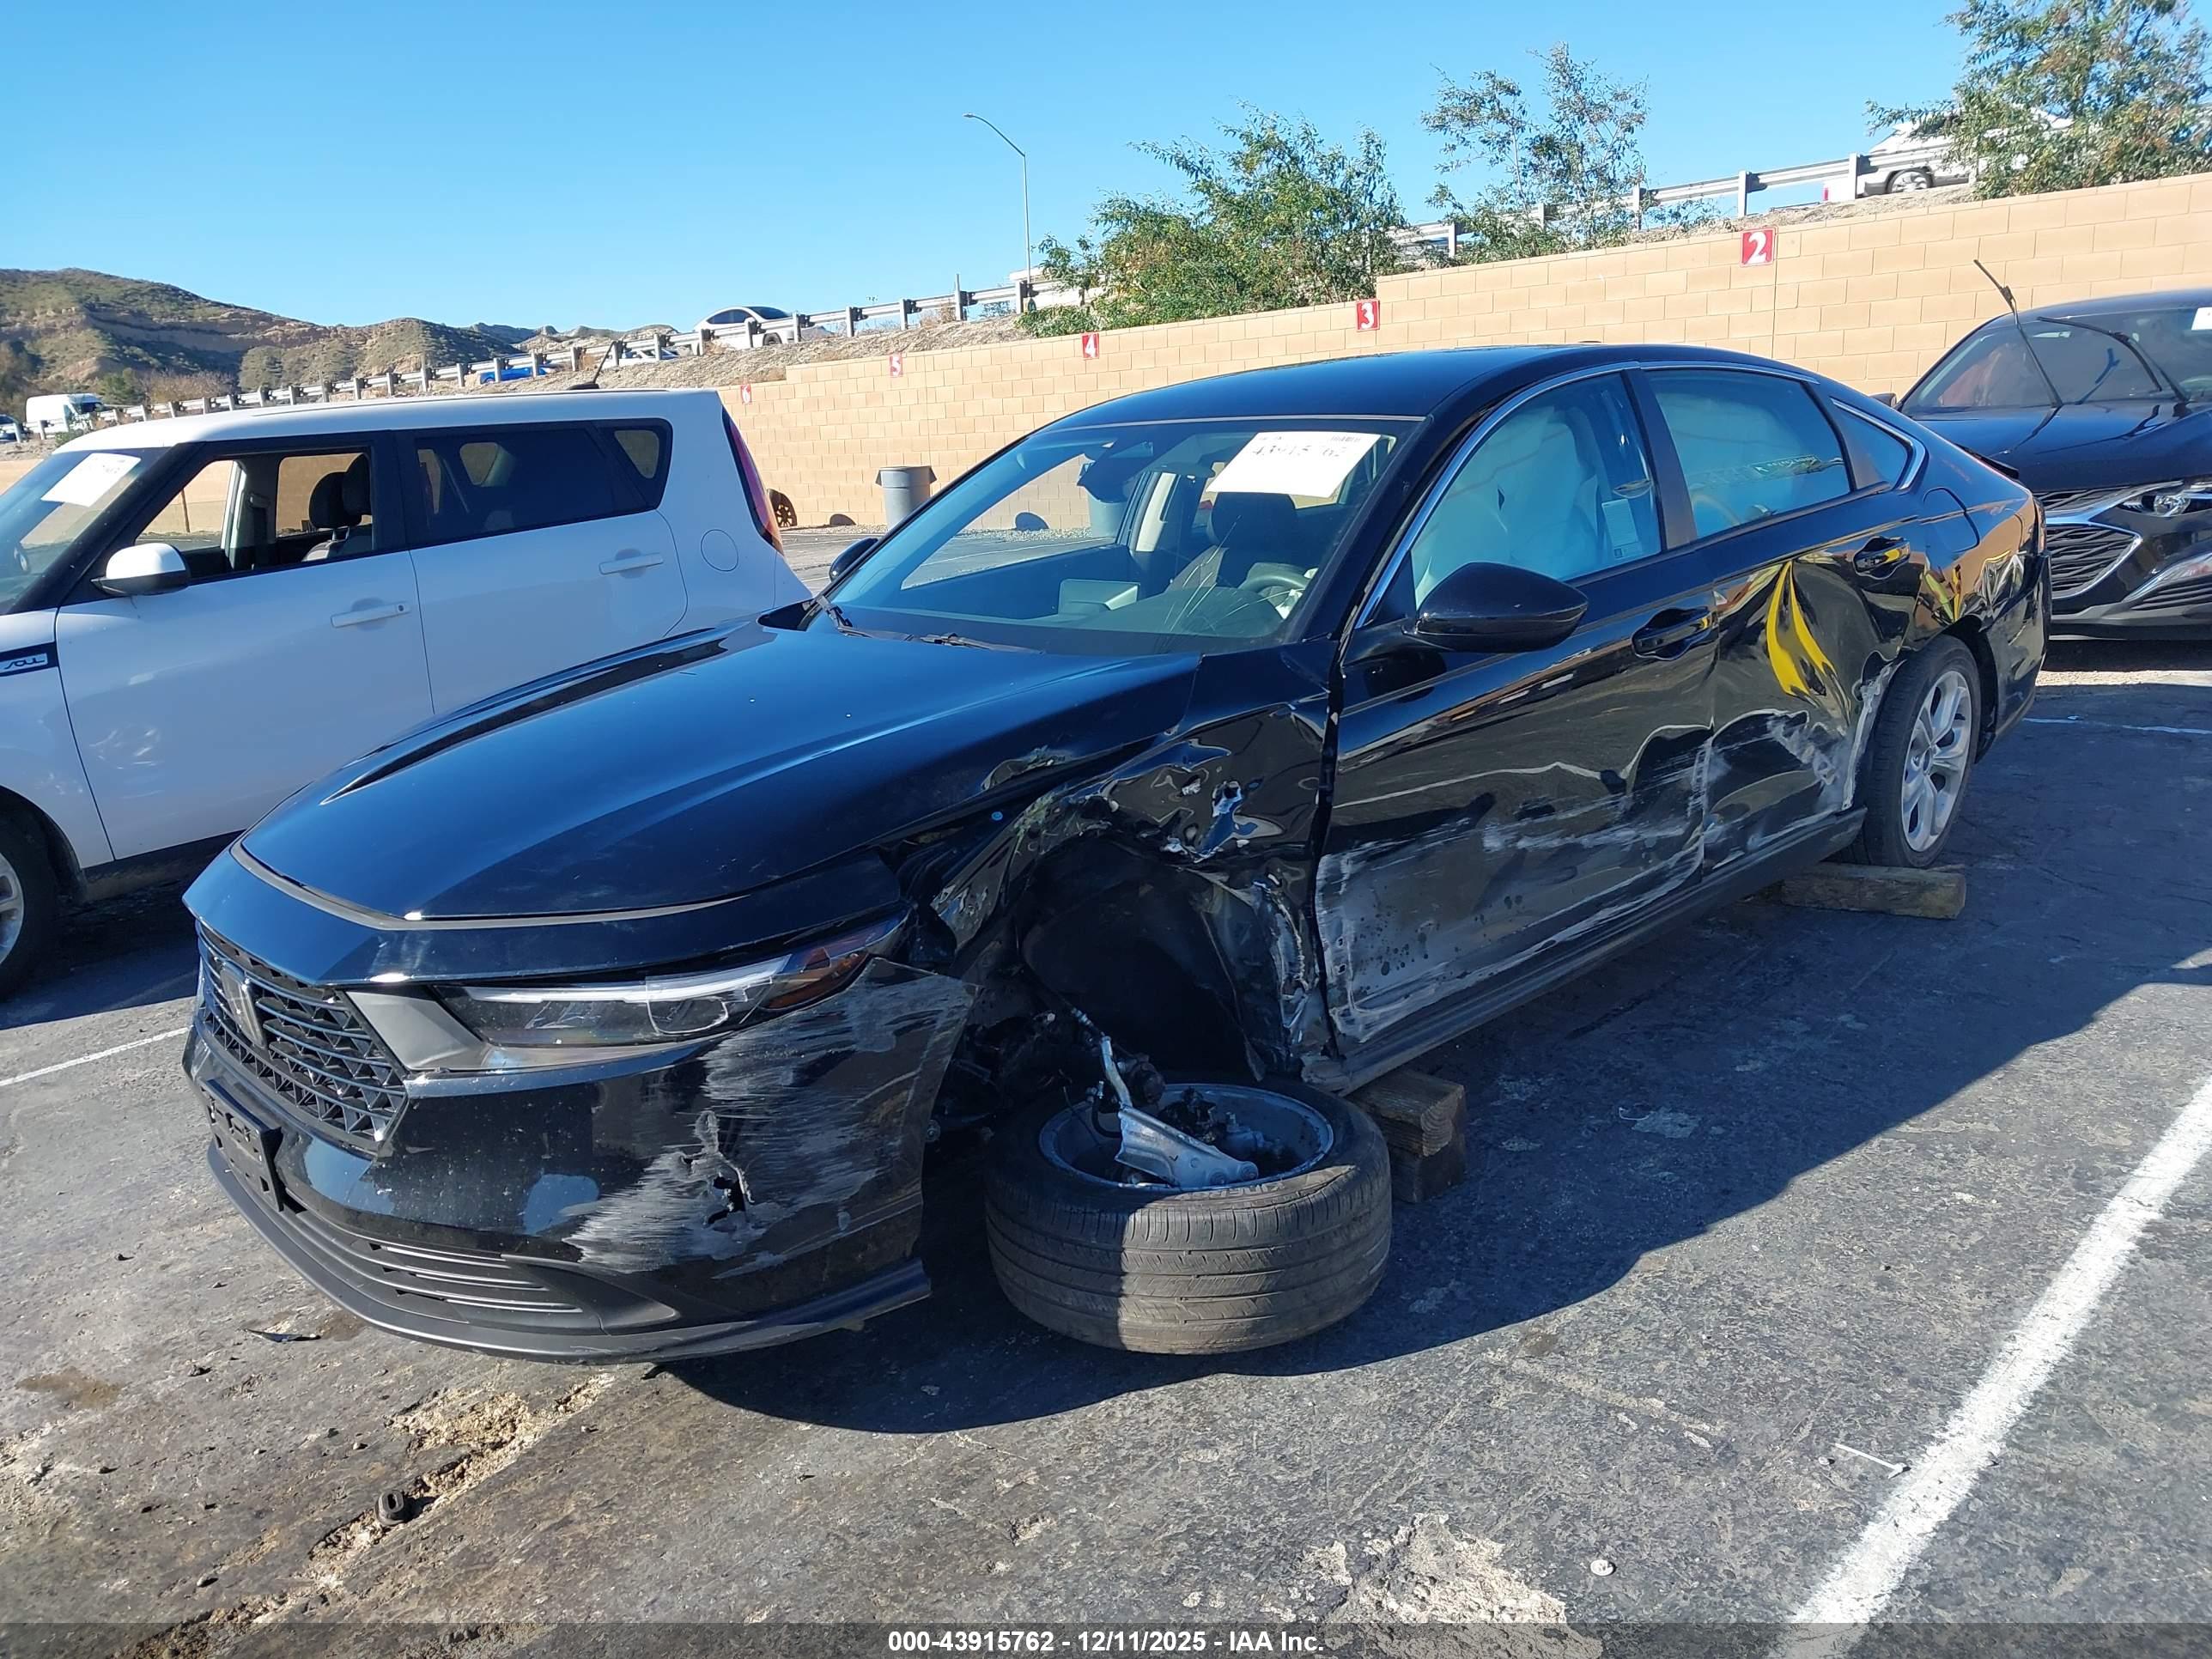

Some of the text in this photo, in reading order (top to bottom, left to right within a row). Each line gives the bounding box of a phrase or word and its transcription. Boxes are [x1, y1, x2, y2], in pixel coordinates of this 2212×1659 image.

[1747, 231, 1767, 264] 2
[1360, 301, 1374, 329] 3
[1085, 334, 1097, 357] 4
[891, 356, 901, 376] 5
[742, 386, 750, 404] 6
